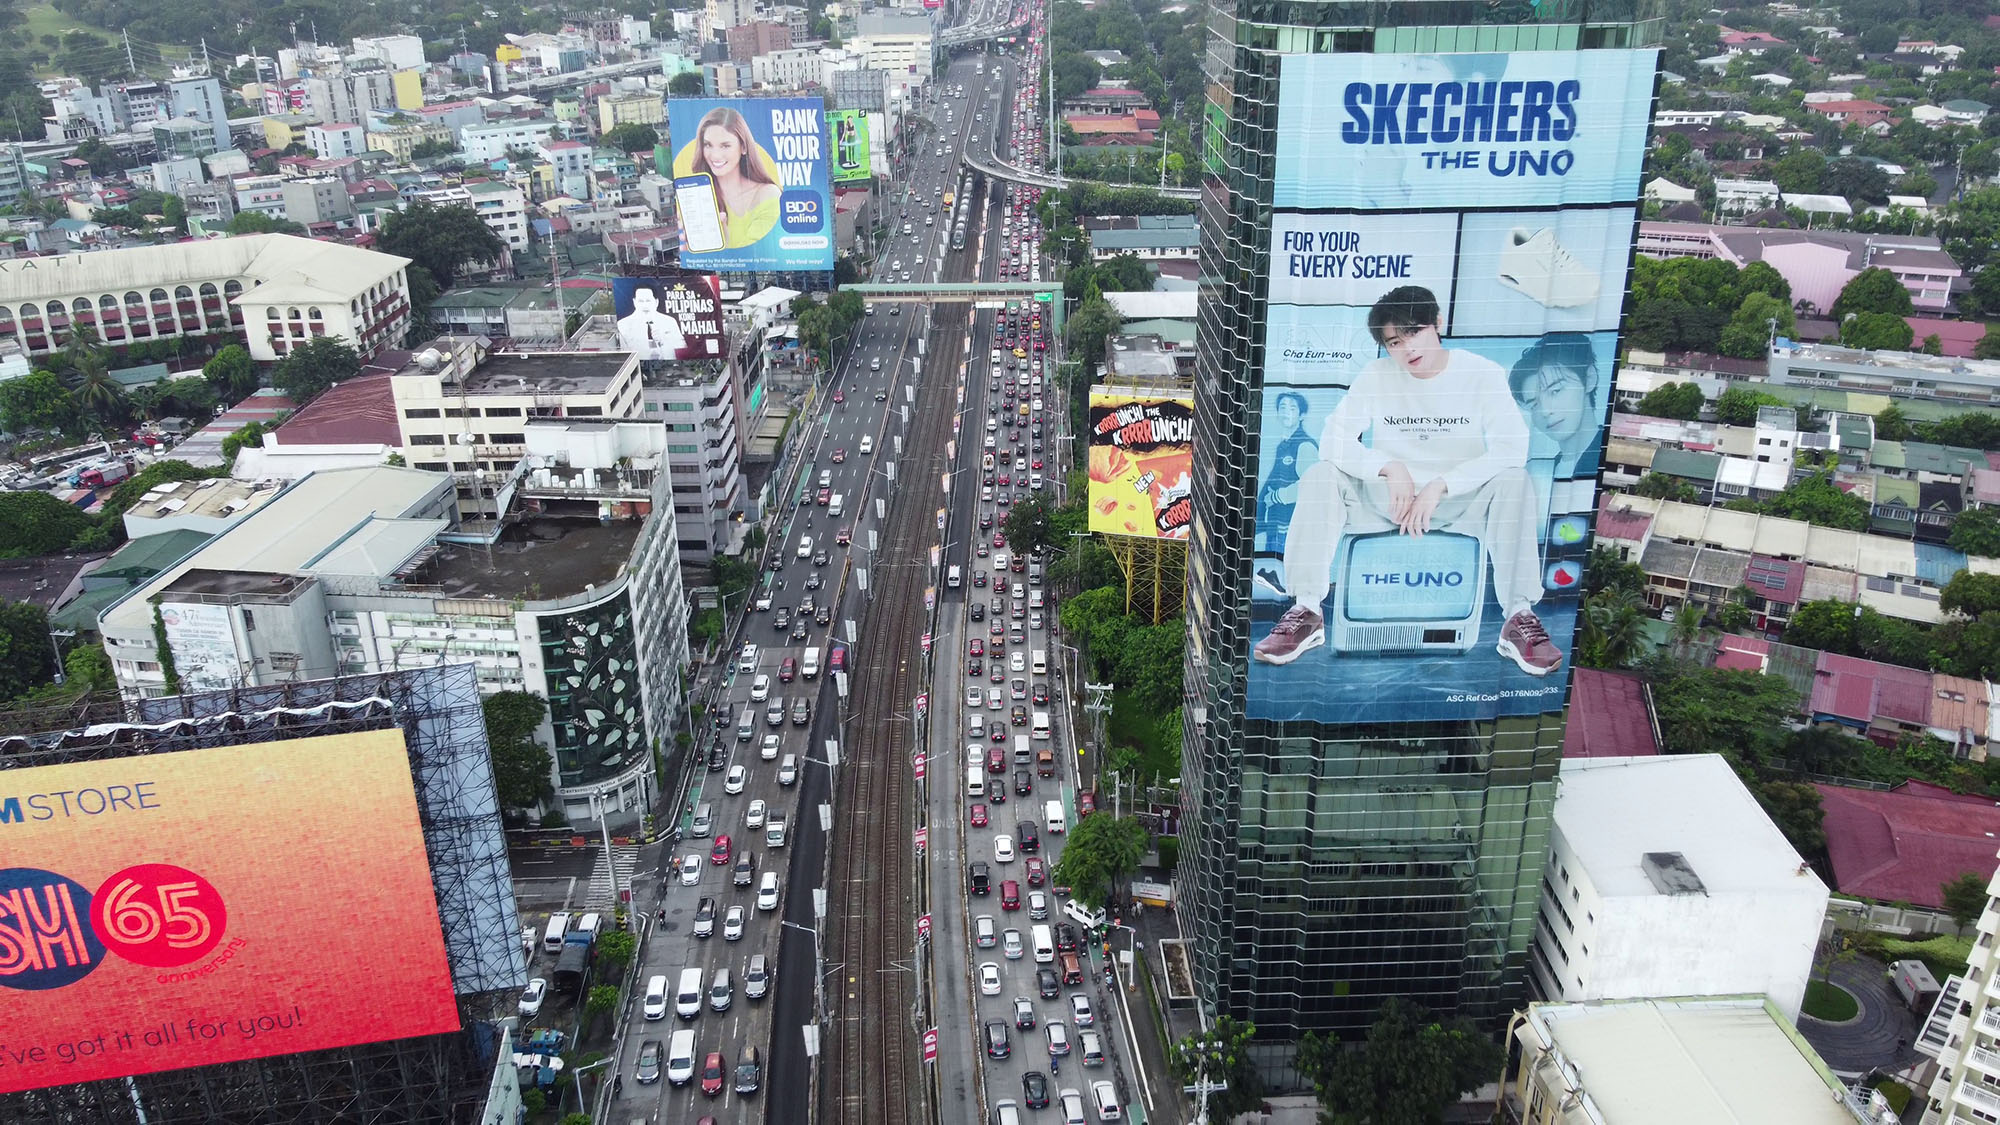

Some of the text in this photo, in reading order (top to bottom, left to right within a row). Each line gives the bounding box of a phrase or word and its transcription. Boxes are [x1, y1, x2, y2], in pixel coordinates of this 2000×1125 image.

[772, 109, 819, 134] BANK
[1341, 79, 1580, 145] SKECHERS
[773, 136, 820, 160] YOUR
[1421, 149, 1575, 178] THE UNO
[776, 162, 813, 186] WAY
[786, 201, 817, 213] BDO
[787, 213, 818, 223] online
[1283, 231, 1360, 253] FOR YOUR
[1289, 254, 1413, 280] EVERY SCENE
[666, 290, 697, 300] PARA SA
[665, 299, 714, 313] PILIPINAS
[679, 313, 696, 321] KONG
[681, 320, 719, 335] MAHAL
[1283, 349, 1304, 359] Cha
[1145, 406, 1161, 417] THE
[1383, 416, 1471, 427] Skechers sports
[1134, 471, 1155, 492] NEW
[1159, 498, 1191, 529] KRRRR
[1362, 571, 1463, 588] THE UNO
[1446, 694, 1465, 703] ASC
[1465, 694, 1480, 702] Ref
[27, 782, 161, 821] STORE
[932, 817, 957, 829] ONLY
[933, 849, 956, 861] BUS
[103, 878, 211, 949] 65
[156, 936, 248, 985] anniversary
[57, 1033, 106, 1064] got
[114, 1030, 135, 1051] it
[144, 1022, 178, 1047] all
[185, 1018, 229, 1041] for
[238, 1006, 303, 1040] you!
